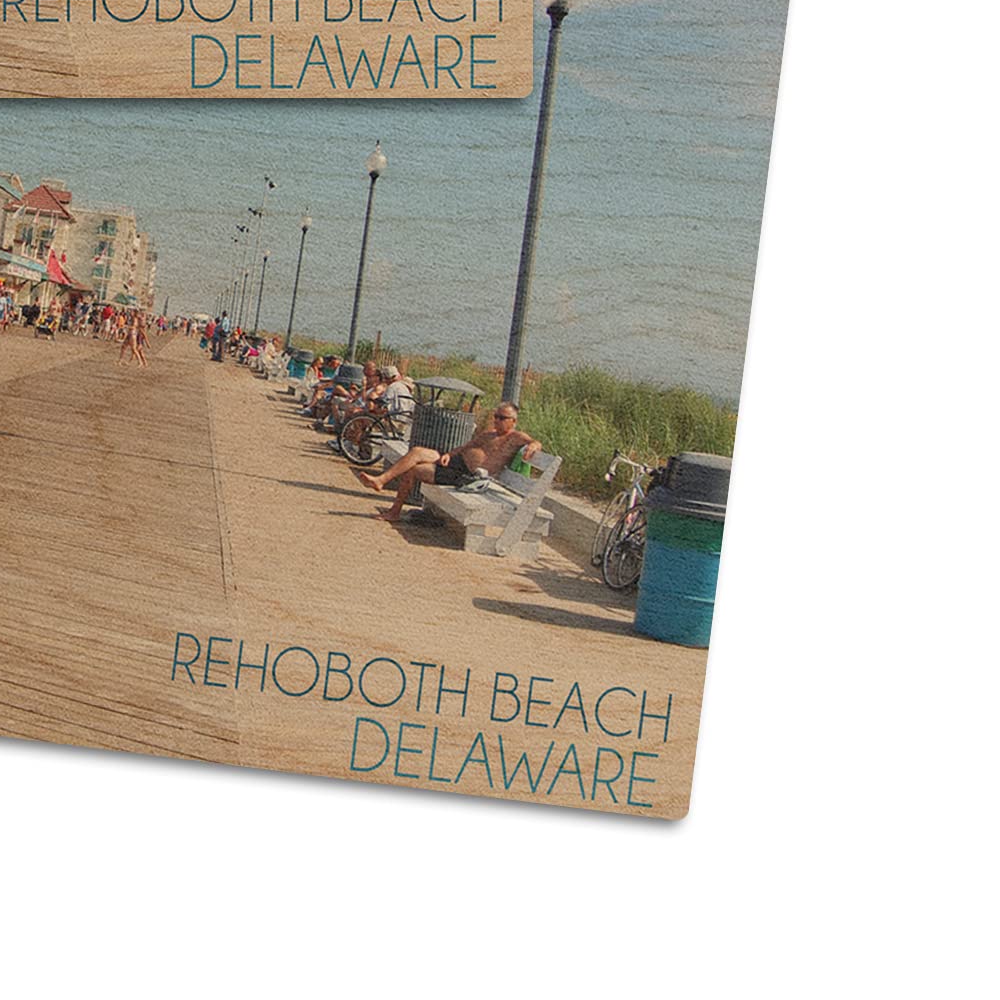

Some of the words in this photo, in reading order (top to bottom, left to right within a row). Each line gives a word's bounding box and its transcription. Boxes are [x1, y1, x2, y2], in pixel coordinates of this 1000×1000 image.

[192, 35, 496, 88] DELAWARE
[172, 632, 470, 716] REHOBOTH
[490, 672, 672, 741] BEACH
[350, 717, 658, 807] DELAWARE
